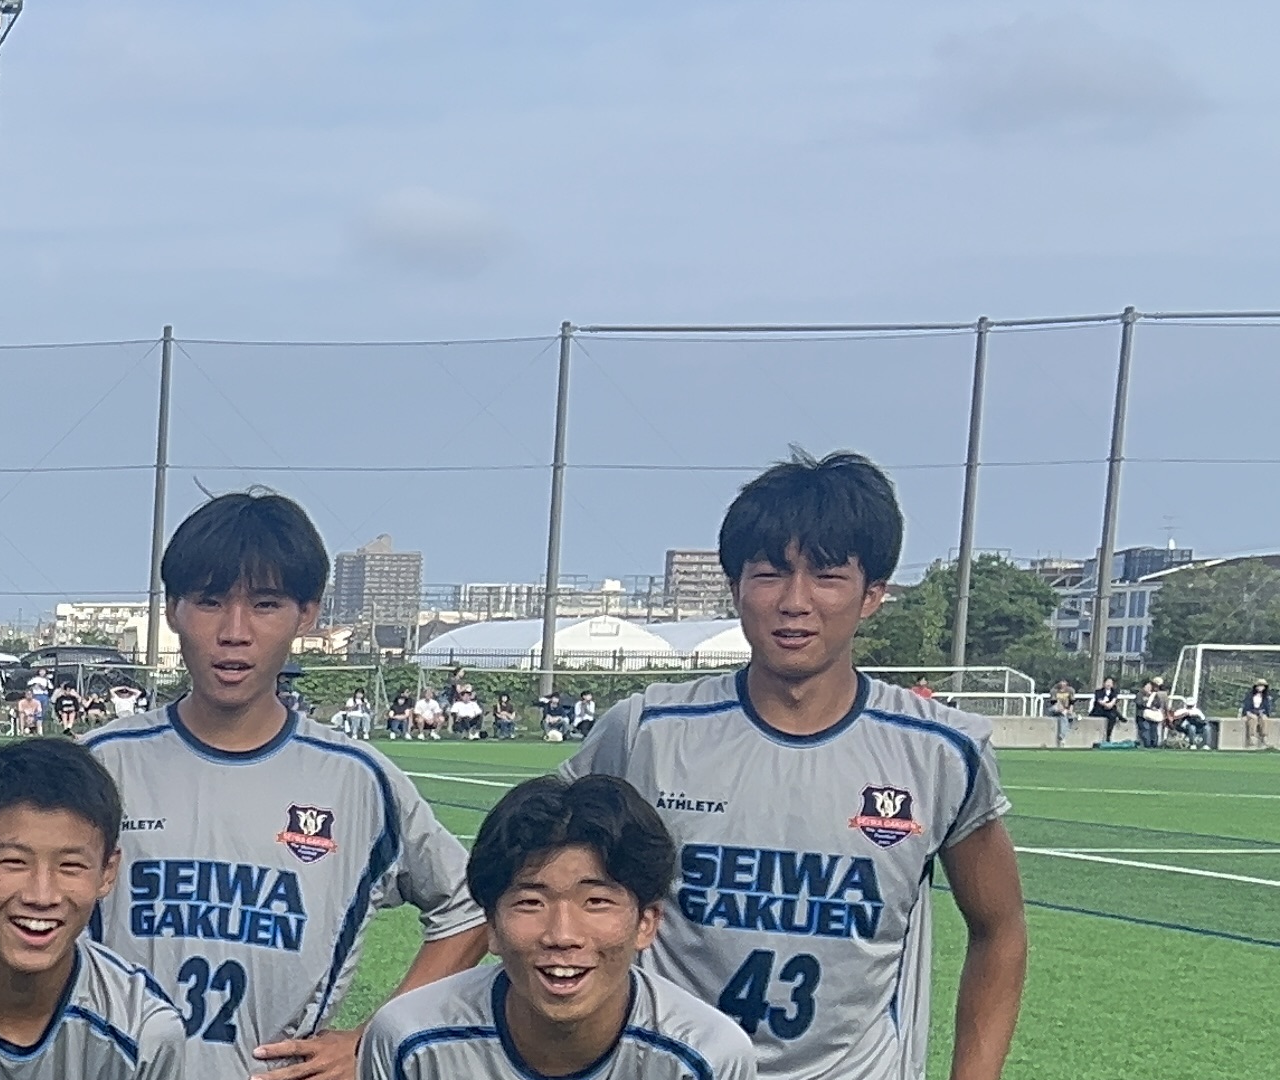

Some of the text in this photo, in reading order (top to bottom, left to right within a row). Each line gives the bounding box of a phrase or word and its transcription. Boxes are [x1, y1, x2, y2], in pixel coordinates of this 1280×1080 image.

[121, 819, 166, 832] HLETA
[656, 798, 728, 813] ATHLETA
[128, 859, 307, 917] SEIWA
[680, 844, 884, 906] SEIWA
[129, 904, 307, 953] GAKUEN
[677, 887, 885, 941] GAKUEN
[176, 956, 248, 1044] 32
[718, 949, 822, 1041] 43
